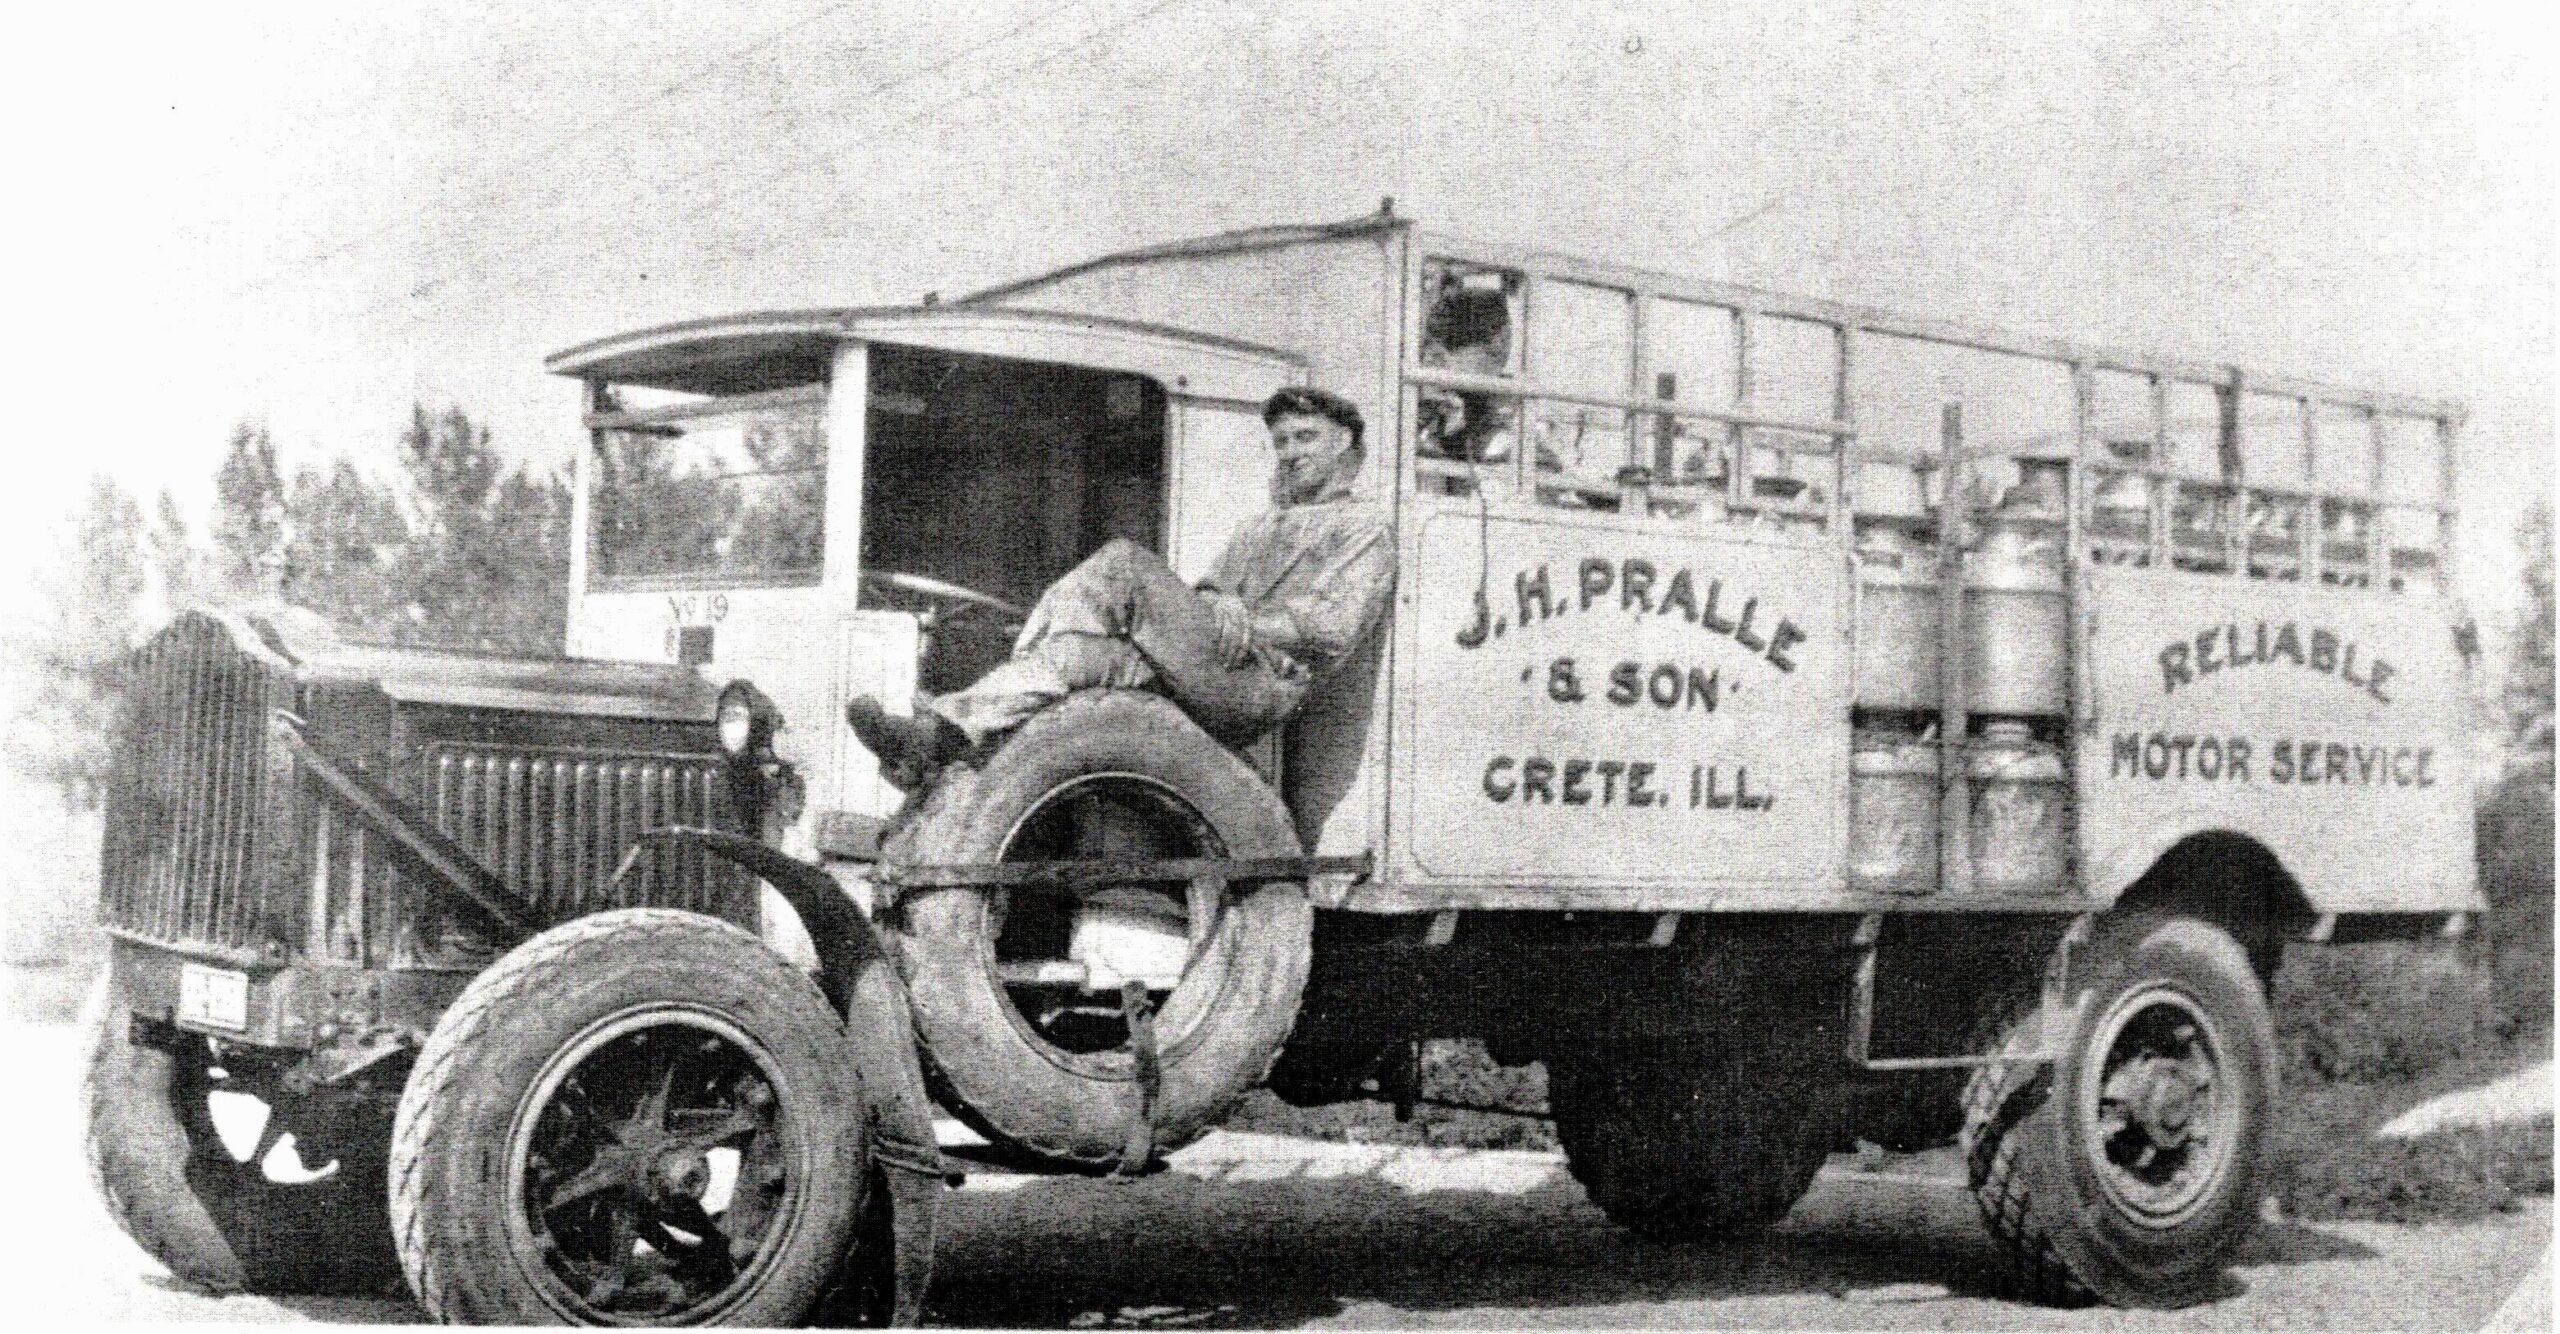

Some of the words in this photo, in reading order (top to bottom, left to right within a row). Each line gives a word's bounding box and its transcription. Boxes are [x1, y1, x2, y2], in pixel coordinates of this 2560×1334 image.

[1548, 657, 1586, 702] &
[1607, 661, 1719, 713] SON
[2158, 622, 2396, 706] RELIABLE
[2110, 731, 2252, 782] MOTOR
[2269, 739, 2436, 788] SERVICE
